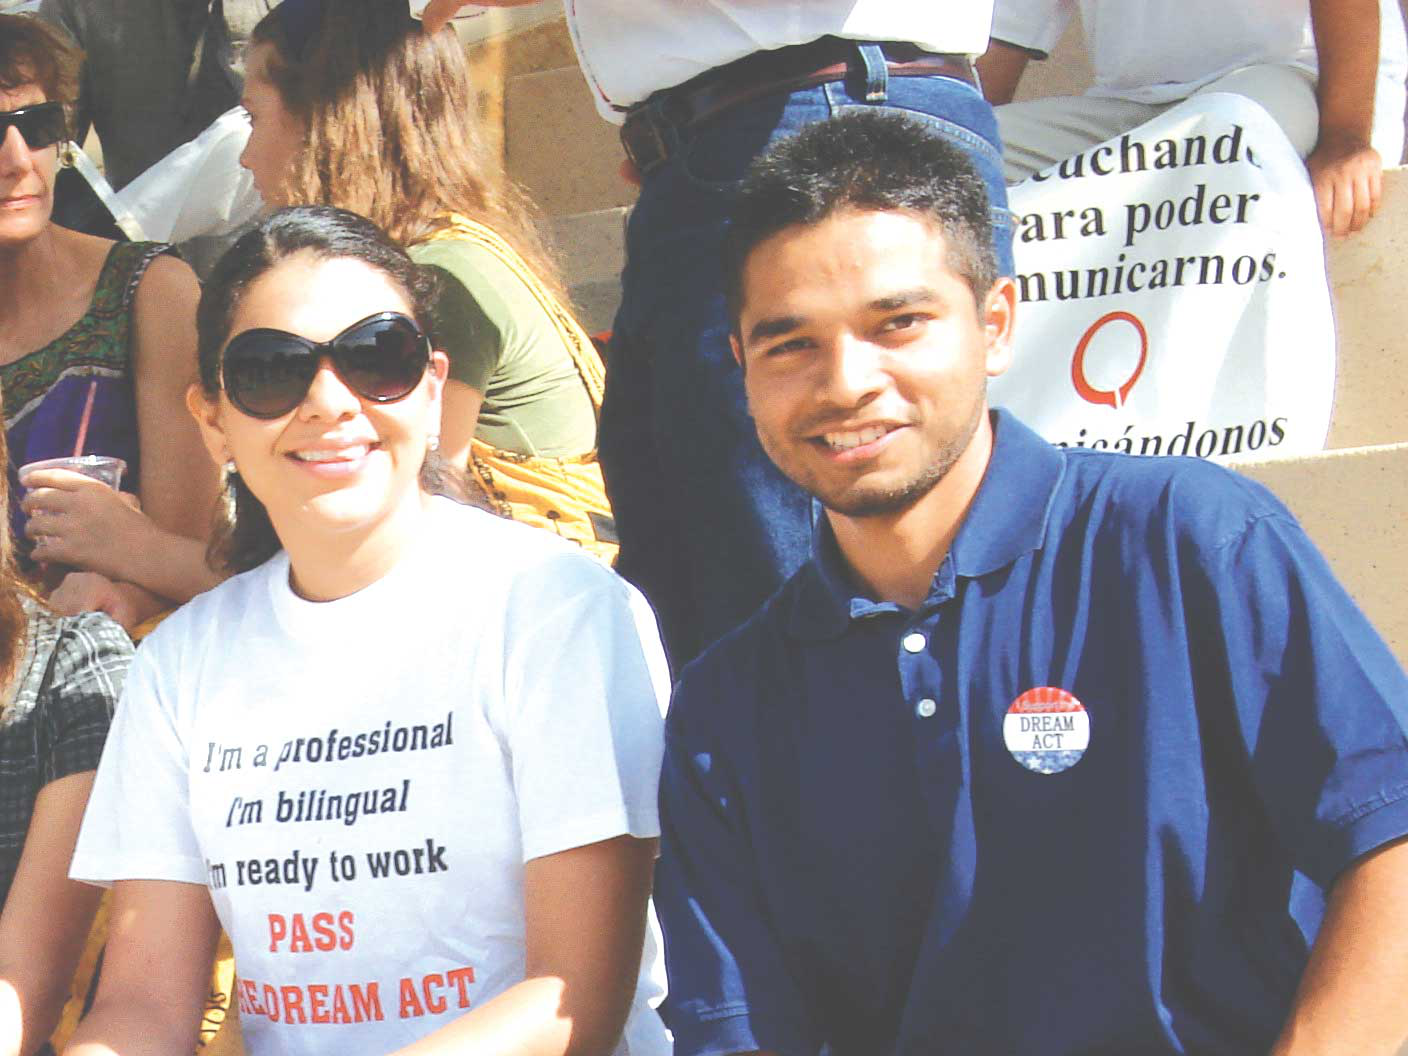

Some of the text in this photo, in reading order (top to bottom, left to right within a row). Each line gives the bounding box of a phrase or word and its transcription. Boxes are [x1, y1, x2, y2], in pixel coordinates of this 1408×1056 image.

[1012, 124, 1263, 186] uchand
[1123, 184, 1261, 247] poder
[203, 711, 454, 773] I'm a professional
[1020, 715, 1075, 732] DREAM
[1032, 733, 1064, 749] ACT
[226, 779, 411, 828] I'm bilingual
[237, 850, 319, 892] ready
[330, 850, 356, 882] to
[367, 838, 449, 879] work
[268, 910, 355, 953] PASS
[398, 966, 475, 1019] ACT
